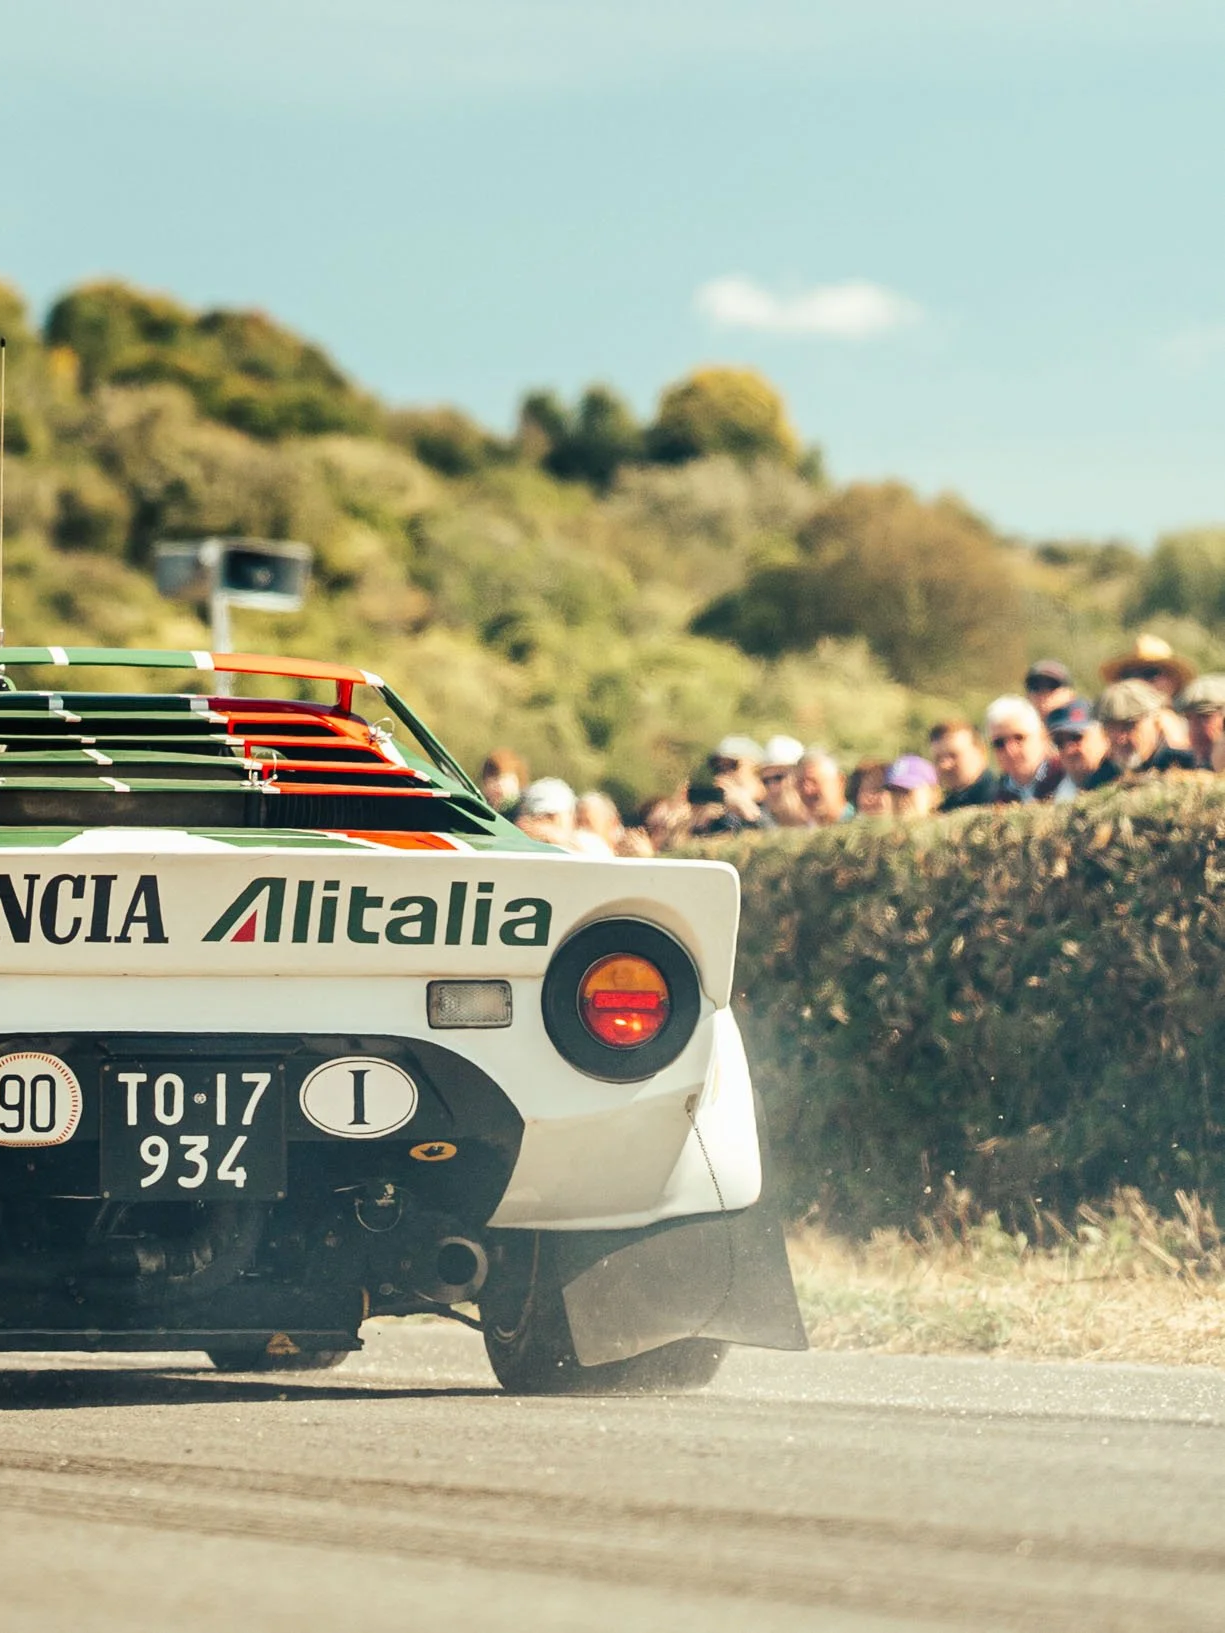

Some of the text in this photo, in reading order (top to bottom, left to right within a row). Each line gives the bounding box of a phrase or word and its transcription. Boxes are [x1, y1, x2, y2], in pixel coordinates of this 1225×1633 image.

[202, 876, 552, 947] Alitalia
[347, 1069, 371, 1125] I
[140, 1135, 248, 1189] 934
